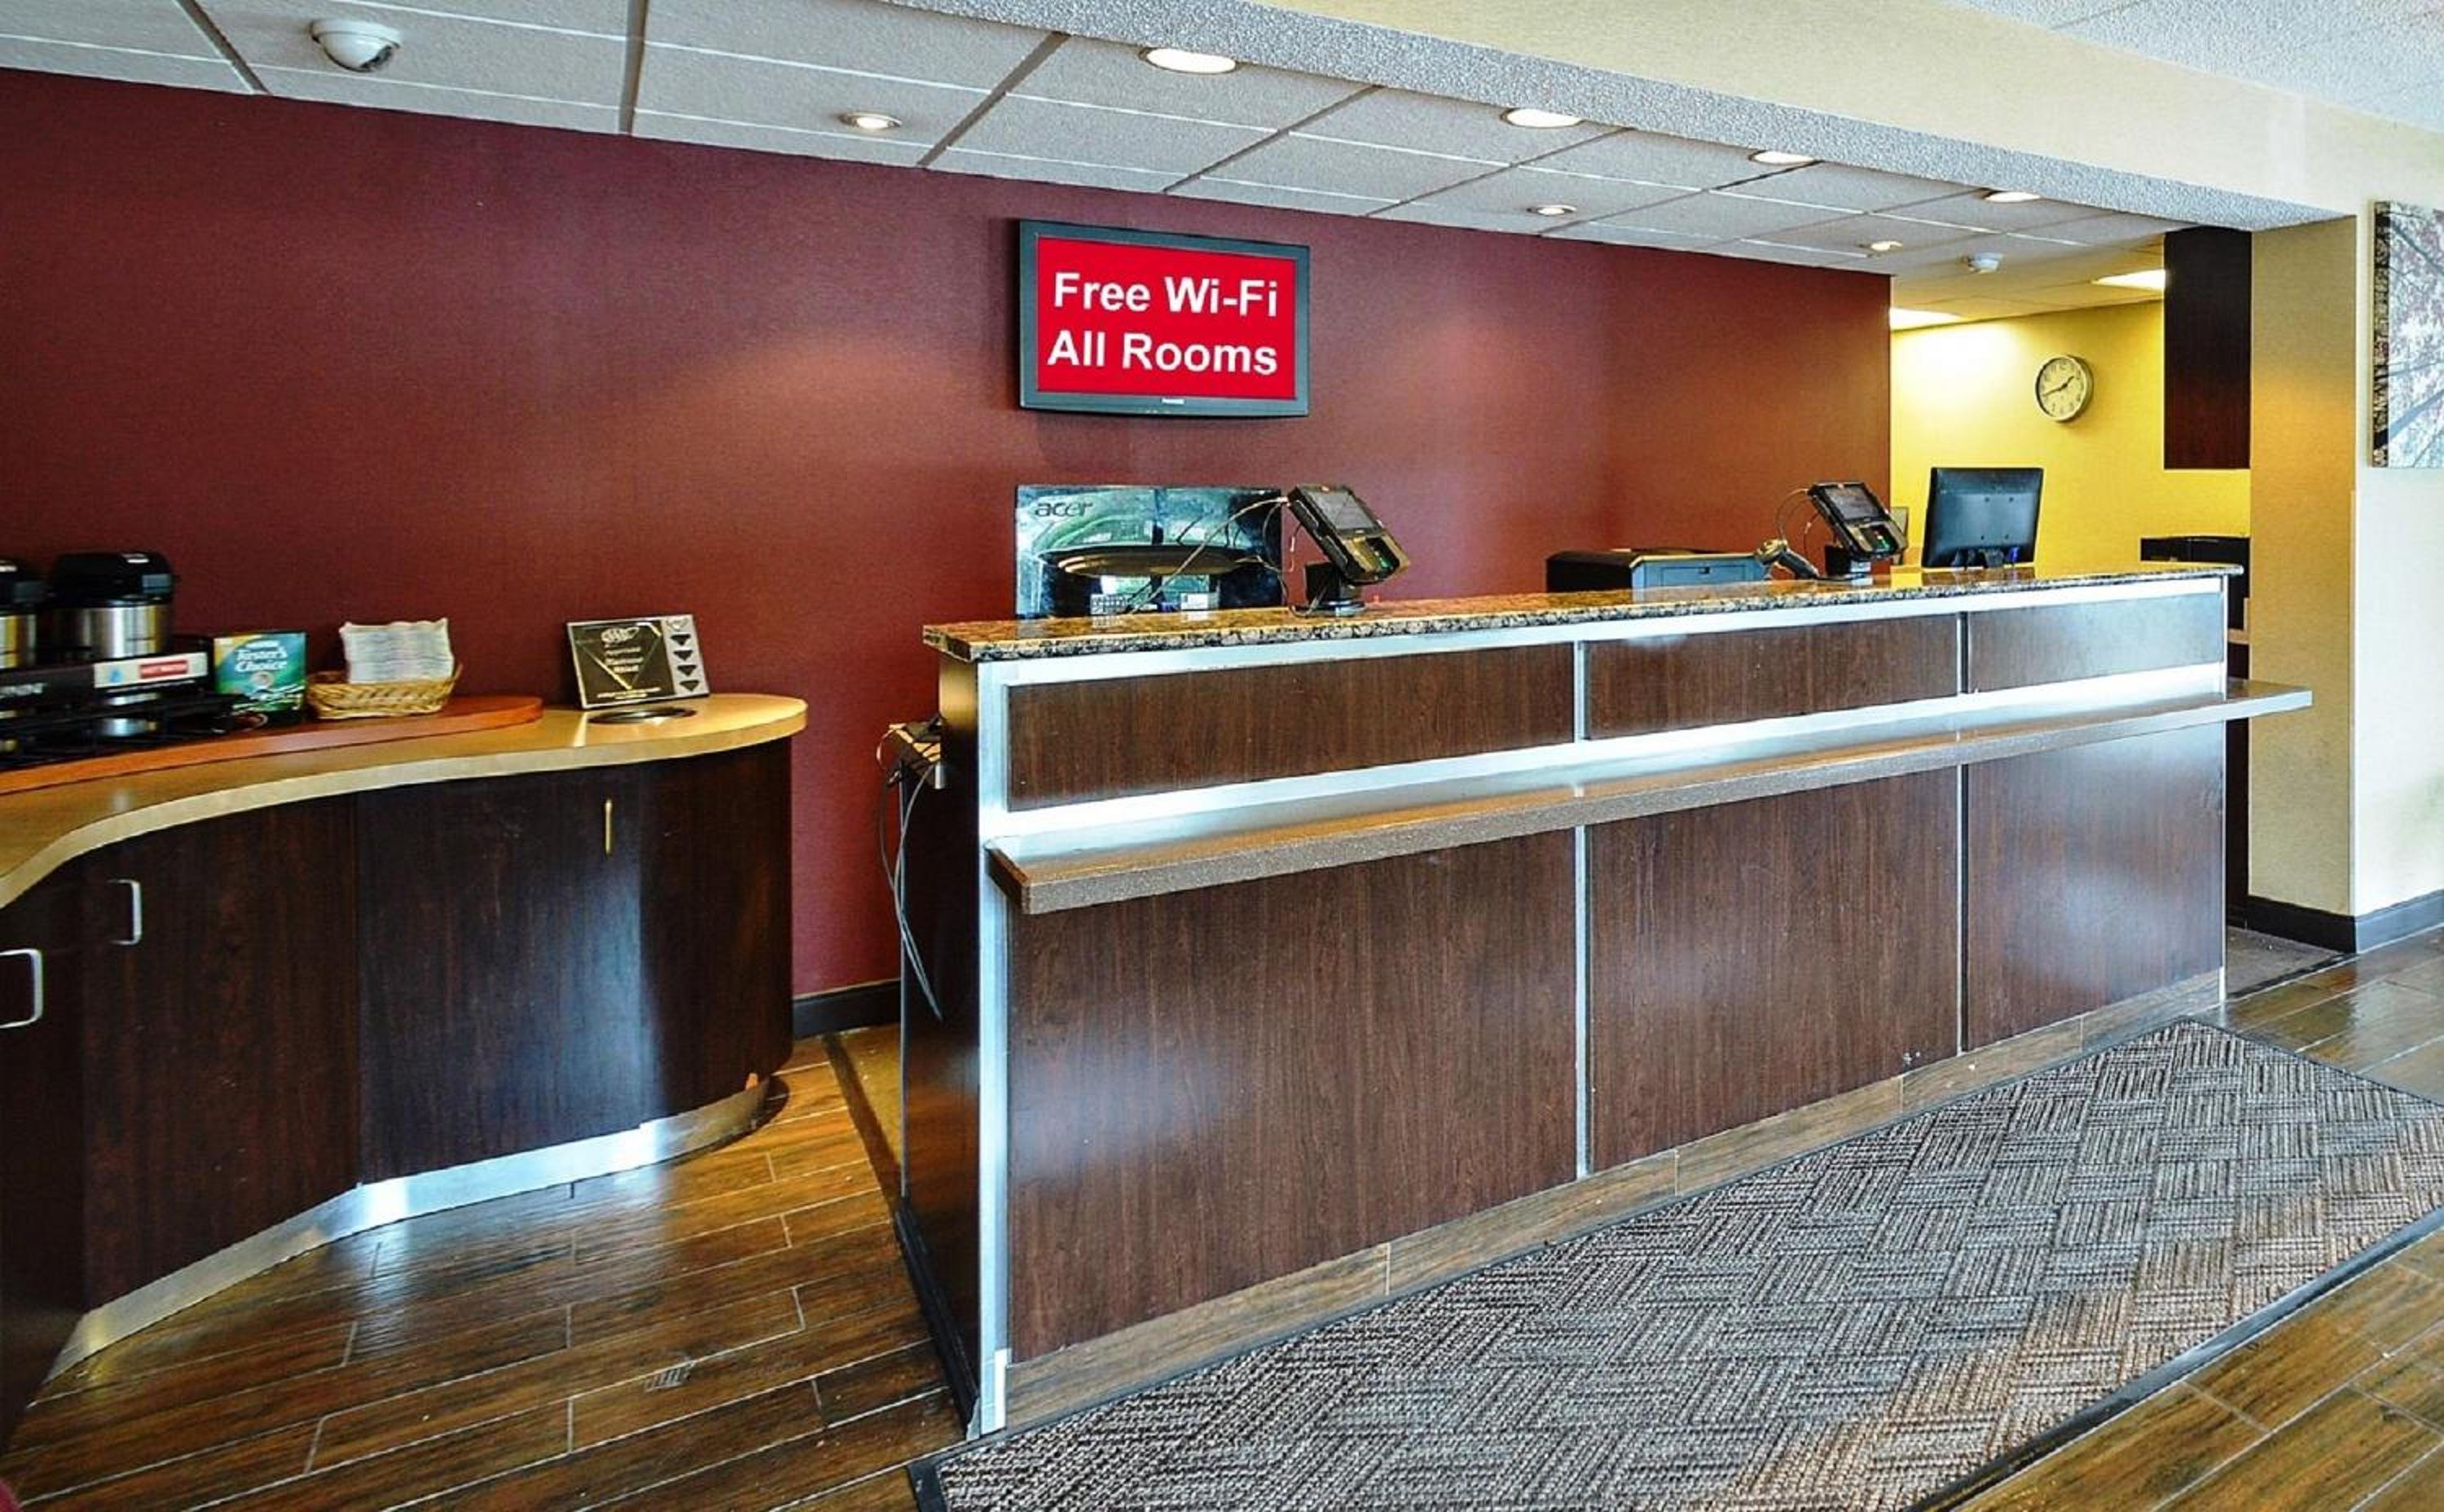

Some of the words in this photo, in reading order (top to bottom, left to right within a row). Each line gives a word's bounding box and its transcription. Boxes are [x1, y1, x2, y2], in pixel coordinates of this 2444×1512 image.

[1054, 271, 1151, 312] Free
[1163, 275, 1278, 317] Wi-Fi
[1047, 329, 1106, 367] All
[1122, 332, 1278, 375] Rooms
[1035, 502, 1093, 516] acer
